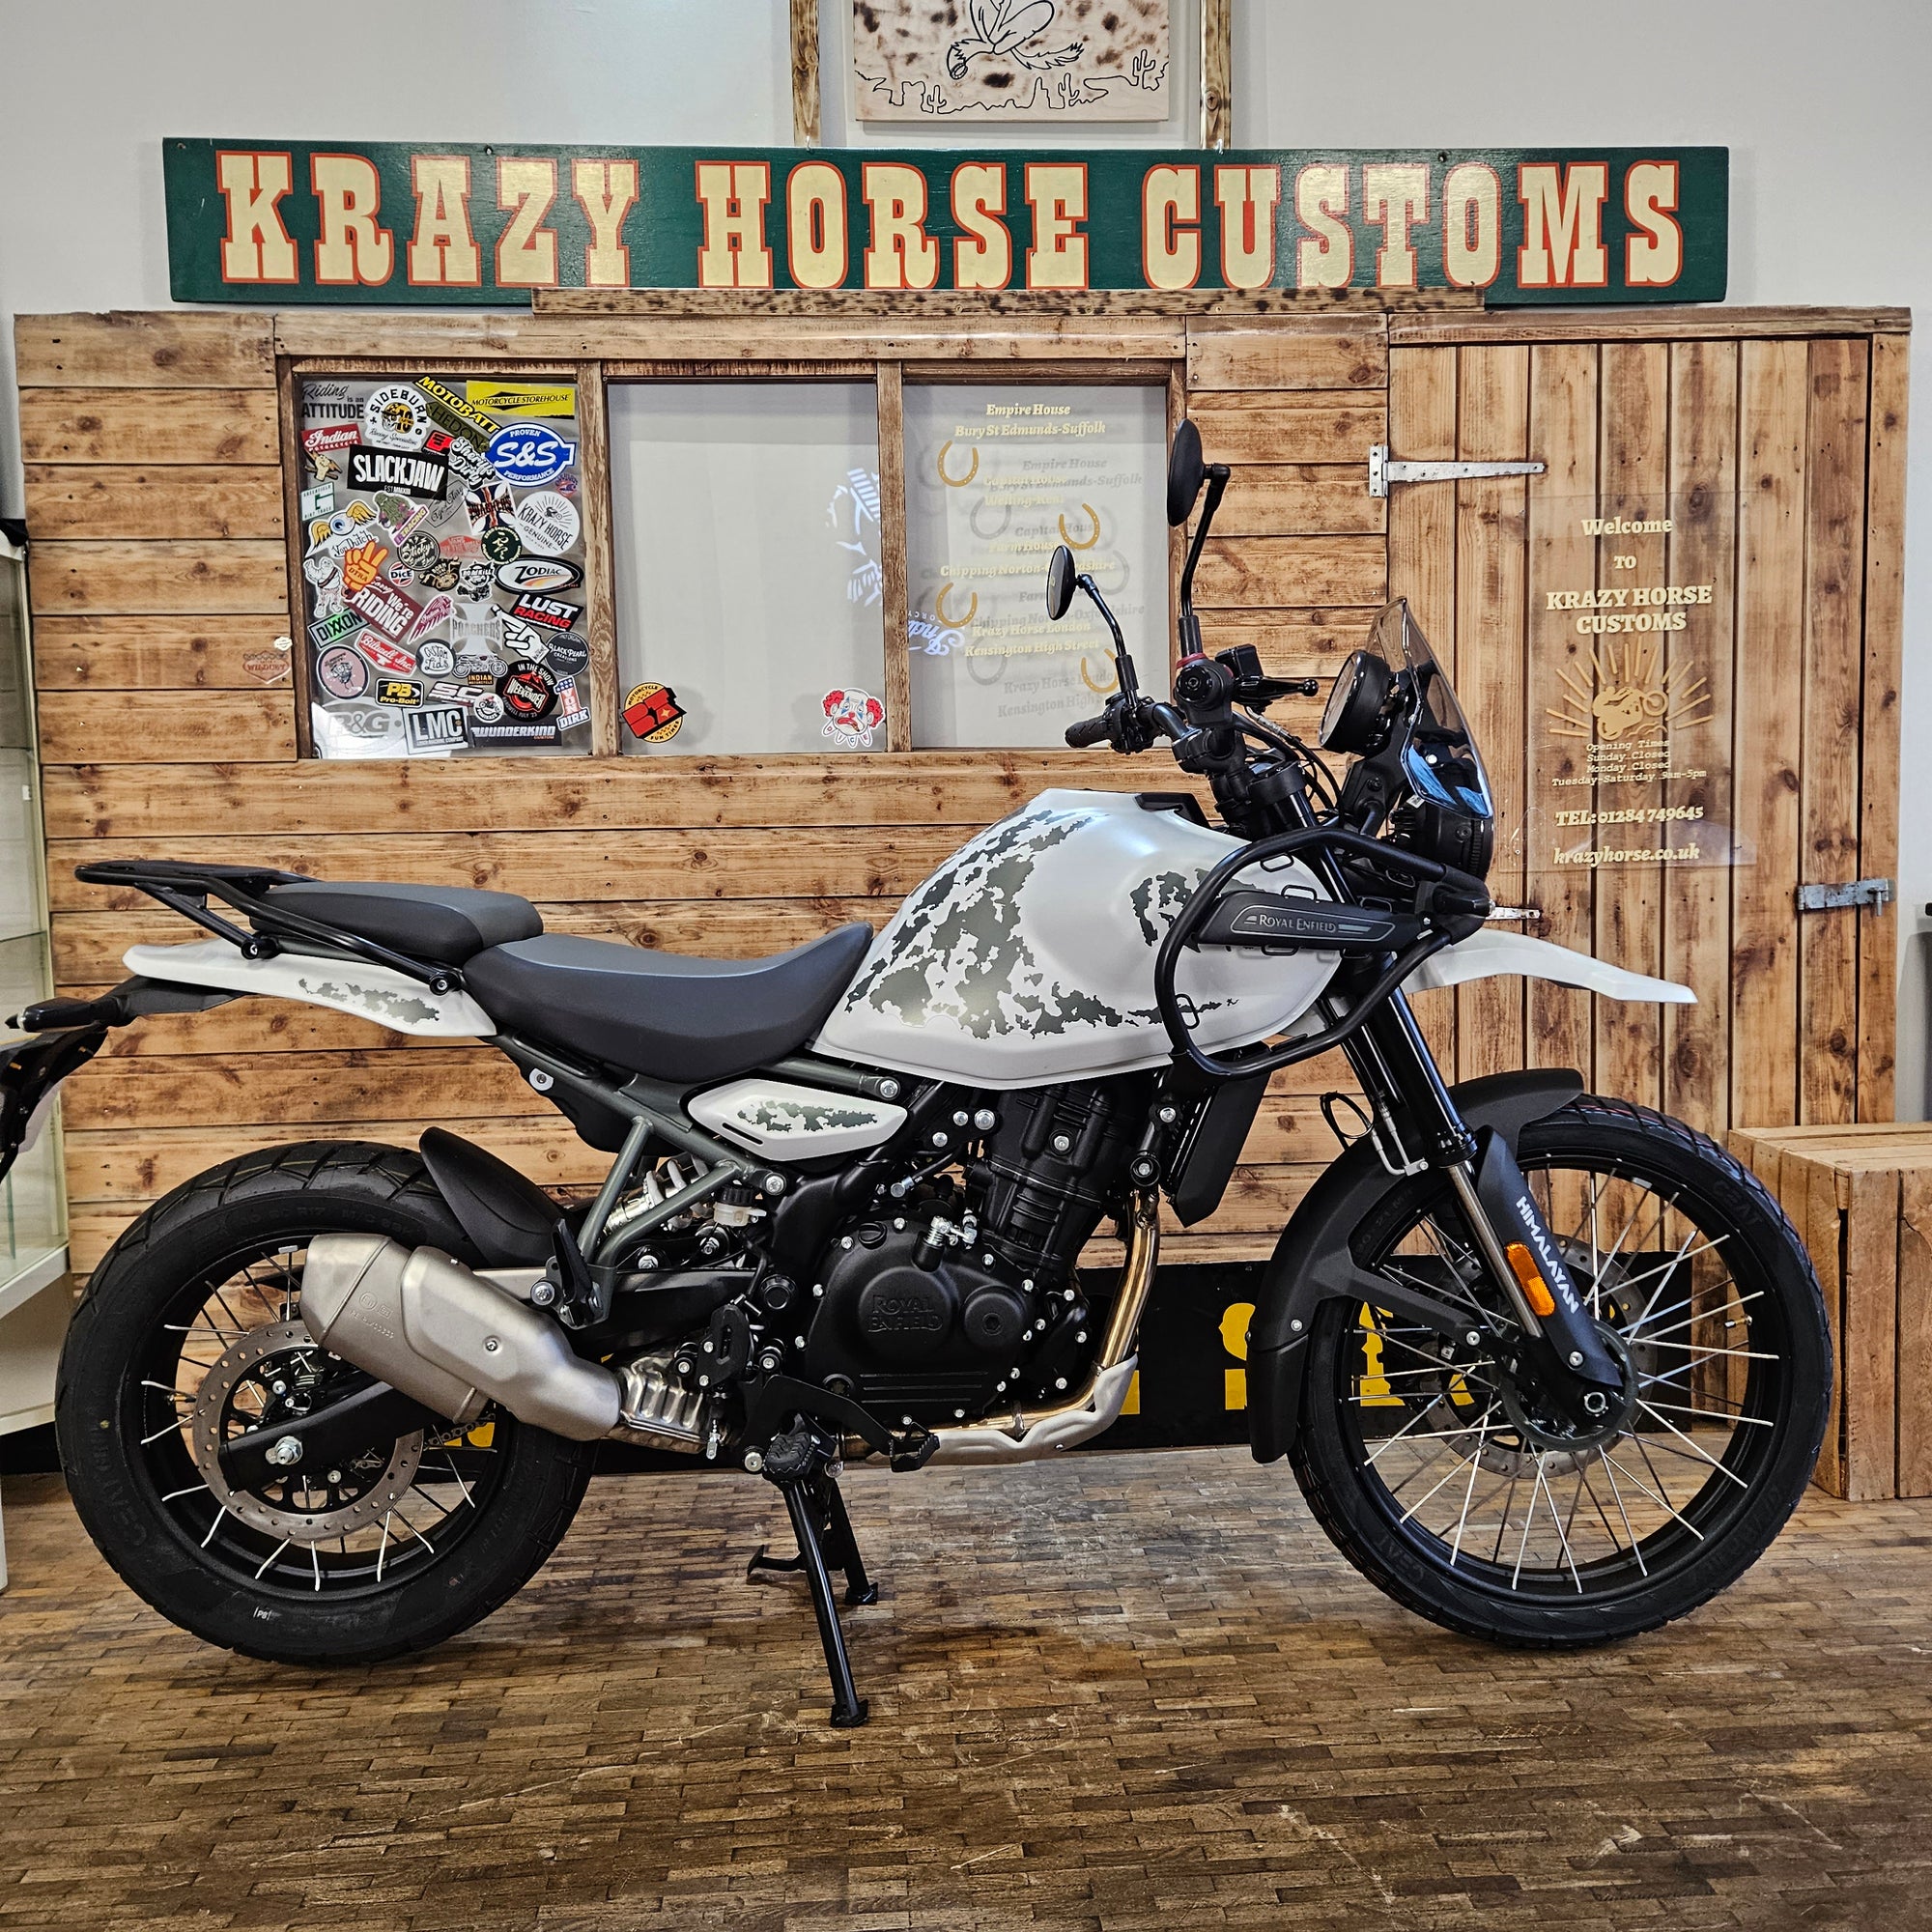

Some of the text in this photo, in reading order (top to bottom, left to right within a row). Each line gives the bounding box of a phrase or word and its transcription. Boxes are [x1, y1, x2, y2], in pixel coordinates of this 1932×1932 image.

[215, 151, 1684, 290] KRAZY HORSE CUSTOMS
[302, 383, 349, 400] Riding
[471, 394, 571, 406] MOTORCYCLE STOREHOUSE
[301, 404, 364, 418] ATTITUDE
[369, 388, 427, 424] SIDEBURN
[419, 377, 499, 433] MOTOBATT
[986, 402, 1071, 416] Empire House
[432, 405, 482, 450] HEDON
[510, 429, 541, 439] PROVEN
[954, 421, 1106, 440] Bury St Edmunds-Suffolk
[304, 429, 358, 448] Indian
[494, 441, 558, 469] S&S
[354, 454, 444, 492] SLACKJAW
[504, 468, 556, 481] PERFORMANCE
[518, 503, 548, 529] KRAZY
[544, 523, 573, 551] HORSE
[1581, 516, 1673, 535] Welcome
[348, 530, 373, 548] Dutch
[524, 526, 553, 549] GENUINE
[1614, 554, 1636, 569] TO
[515, 565, 561, 584] ZODIAC
[387, 592, 414, 619] We're
[519, 593, 579, 618] LUST
[1547, 585, 1713, 611] KRAZY HORSE
[351, 586, 408, 637] RIDING
[514, 607, 571, 628] RACING
[317, 612, 362, 641] DIXXON
[972, 622, 1092, 638] Krazy Horse London
[1576, 612, 1688, 635] CUSTOMS
[965, 639, 1099, 658] Kensington High Street
[538, 668, 554, 686] SHOW
[386, 682, 412, 696] PB
[628, 685, 659, 705] MOTORCYCLE
[380, 696, 416, 705] Pro-Bolt
[412, 710, 463, 741] LMC
[559, 711, 589, 729] DIRK
[471, 725, 555, 738] WUNDERKIND
[826, 725, 869, 744] DICE
[1586, 739, 1670, 753] Opening Times
[1586, 751, 1670, 764] Sunday Closed
[1586, 760, 1671, 775] Monday Closed
[1551, 773, 1657, 787] Tuesday-Saturday
[1647, 806, 1704, 822] 749645
[1552, 841, 1700, 867] krazyhorse.co.uk
[1259, 914, 1337, 933] ROYAL ENFIELD
[1516, 1196, 1579, 1315] HIMALAYAN
[871, 1294, 935, 1316] ROYAL
[868, 1315, 945, 1333] ENFIELD
